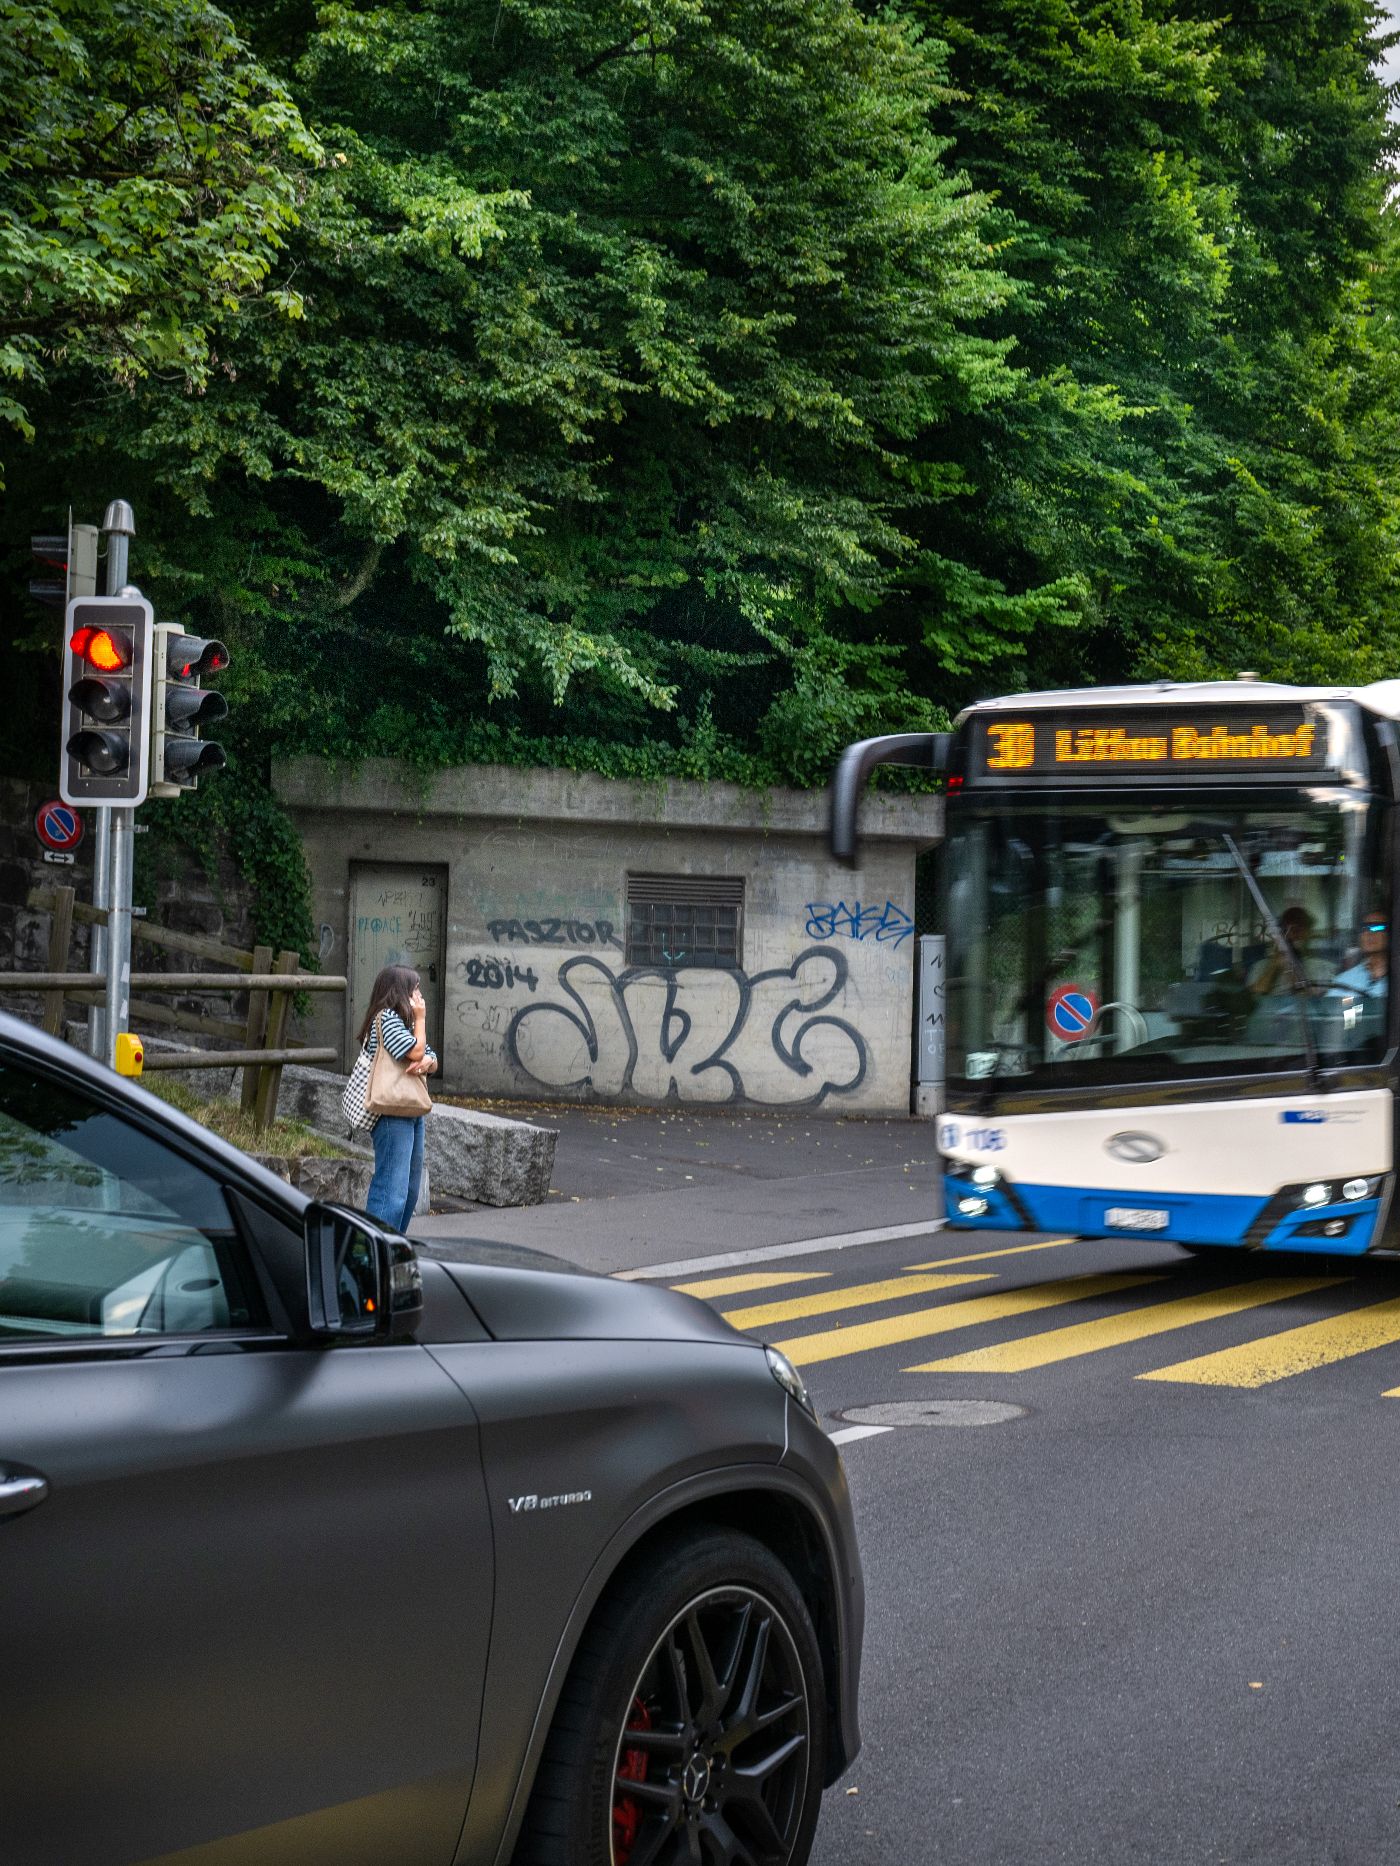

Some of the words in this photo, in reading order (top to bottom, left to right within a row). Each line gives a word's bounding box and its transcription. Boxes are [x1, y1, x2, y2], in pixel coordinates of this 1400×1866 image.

[487, 918, 626, 945] PASZTOR
[466, 958, 539, 993] 2014
[507, 1494, 539, 1514] V8
